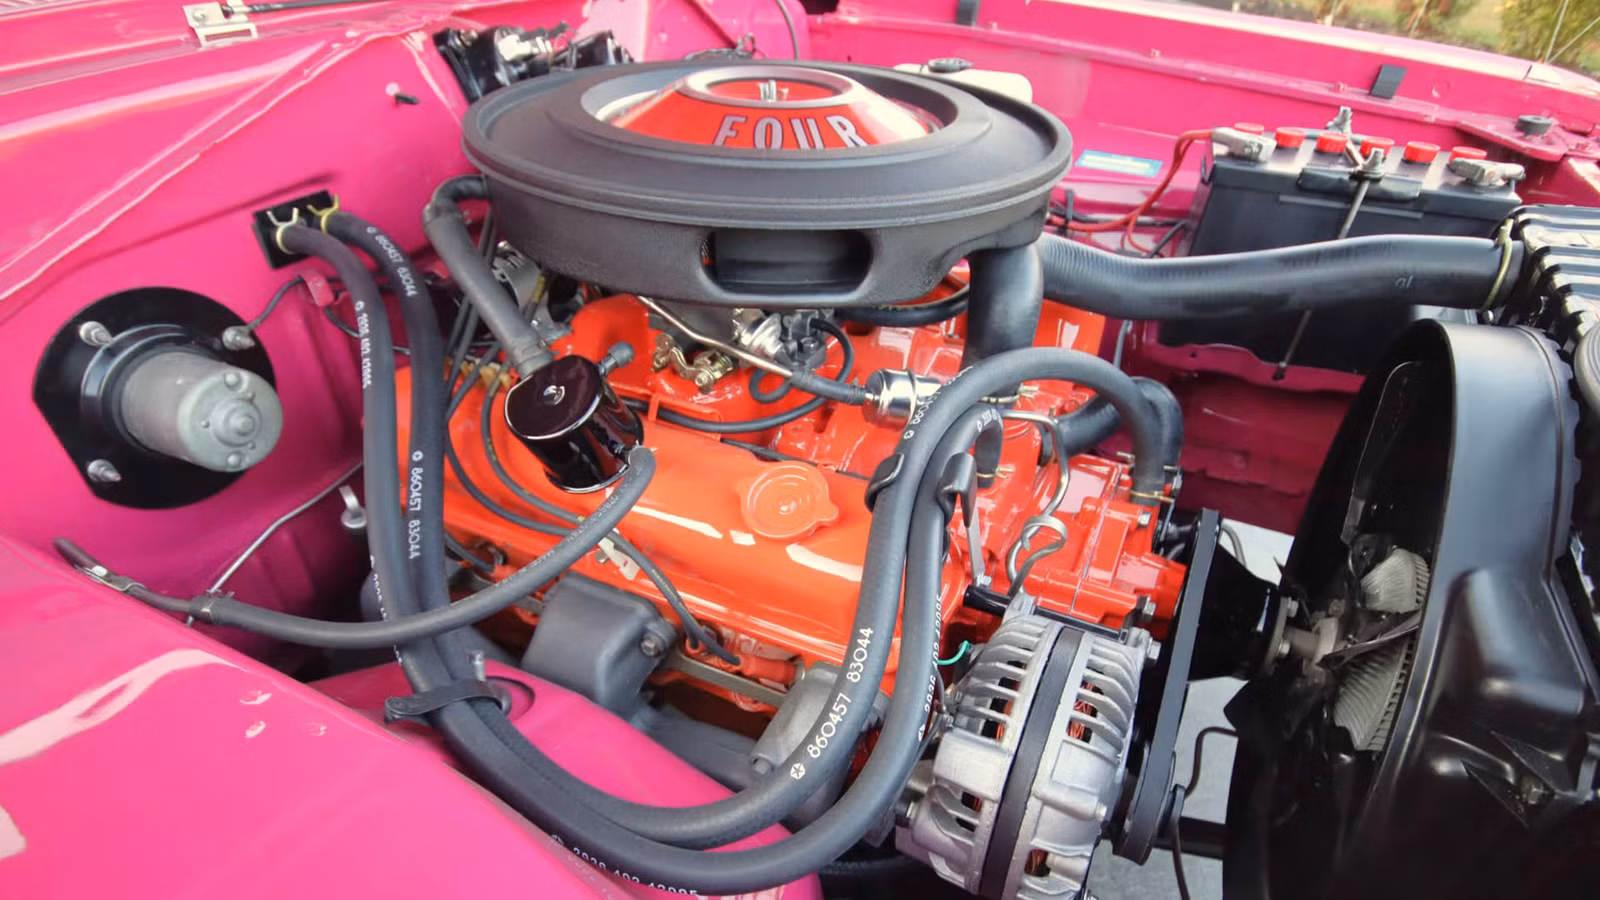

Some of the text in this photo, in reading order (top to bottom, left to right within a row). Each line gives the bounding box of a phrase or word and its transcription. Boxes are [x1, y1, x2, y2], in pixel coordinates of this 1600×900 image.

[714, 114, 869, 149] FOUR
[408, 467, 424, 560] 860457 83044
[806, 627, 874, 759] 860457 83044
